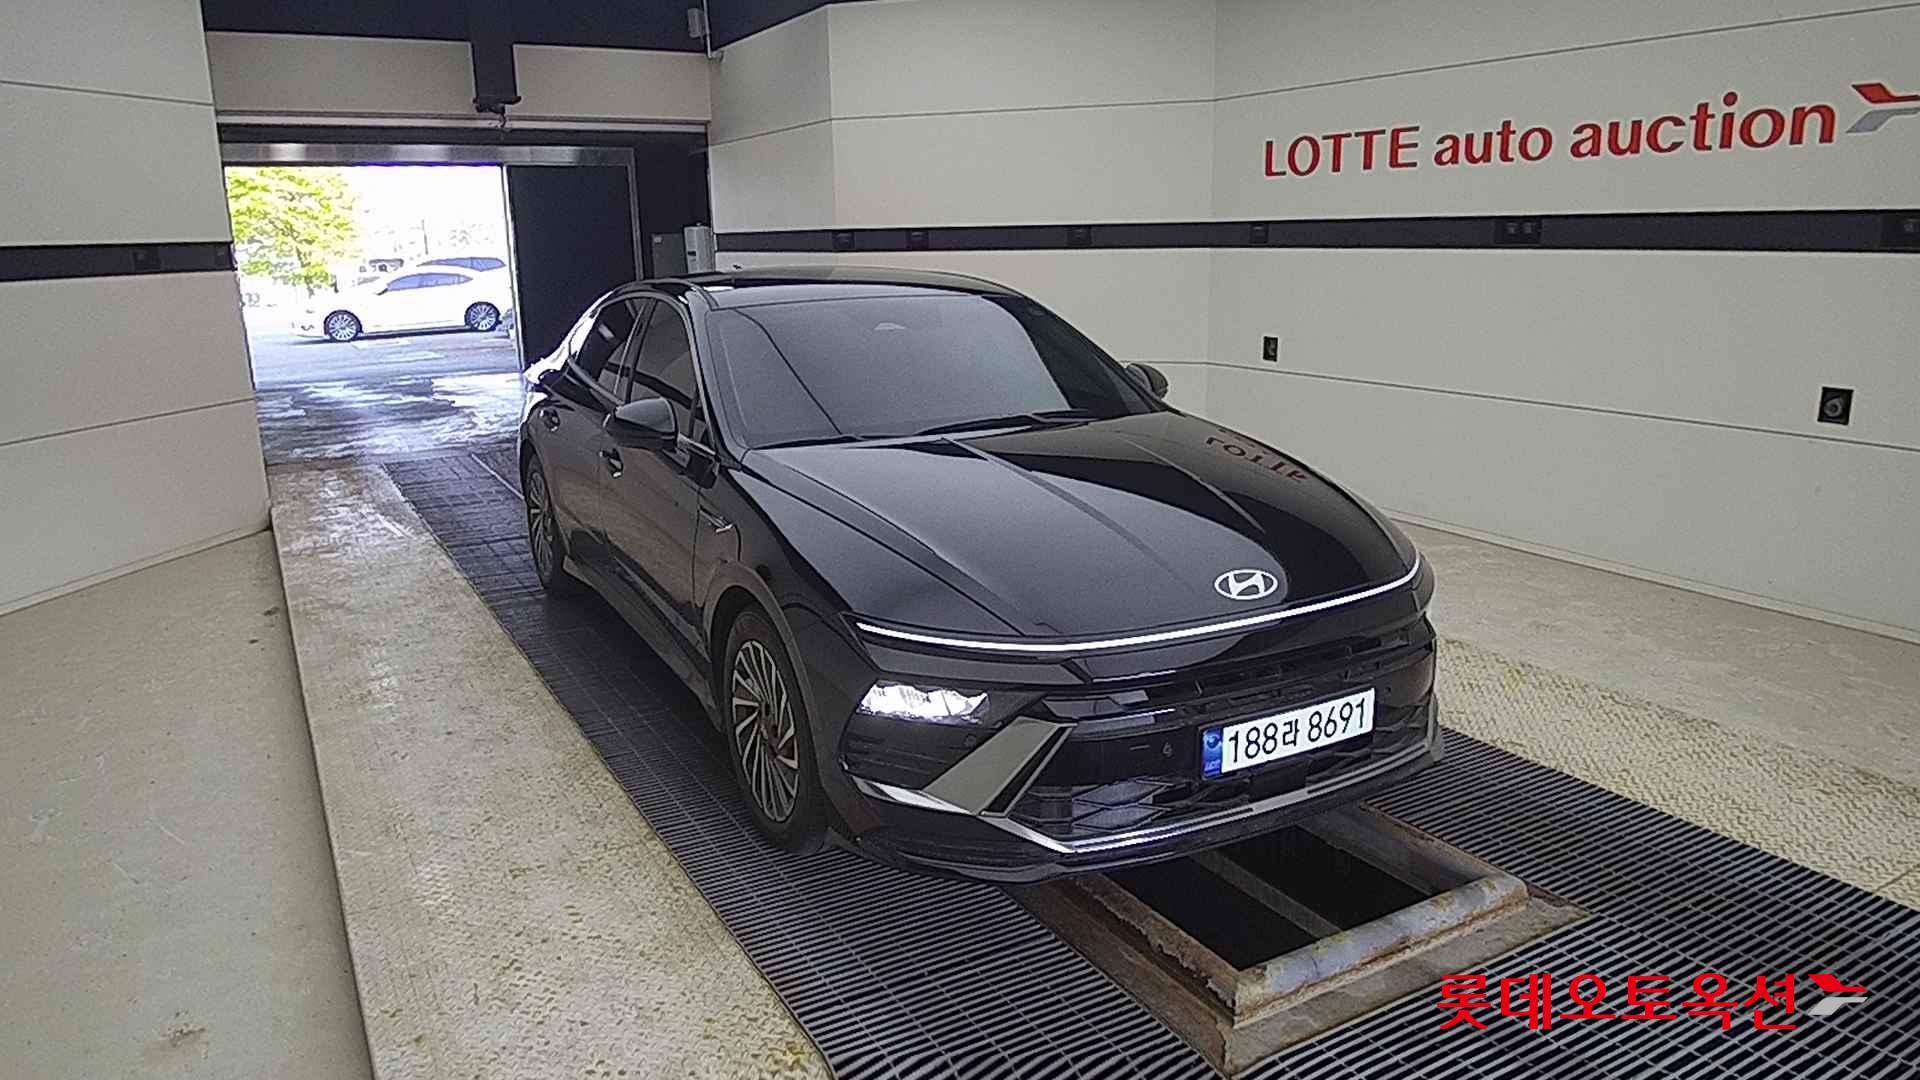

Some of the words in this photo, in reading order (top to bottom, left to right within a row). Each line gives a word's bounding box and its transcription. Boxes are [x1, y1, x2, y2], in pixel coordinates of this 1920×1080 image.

[1264, 126, 1419, 177] LOTTE
[1434, 120, 1553, 167] auto
[1570, 92, 1835, 158] auction
[1228, 718, 1300, 763] 188라
[1307, 697, 1366, 743] 8691
